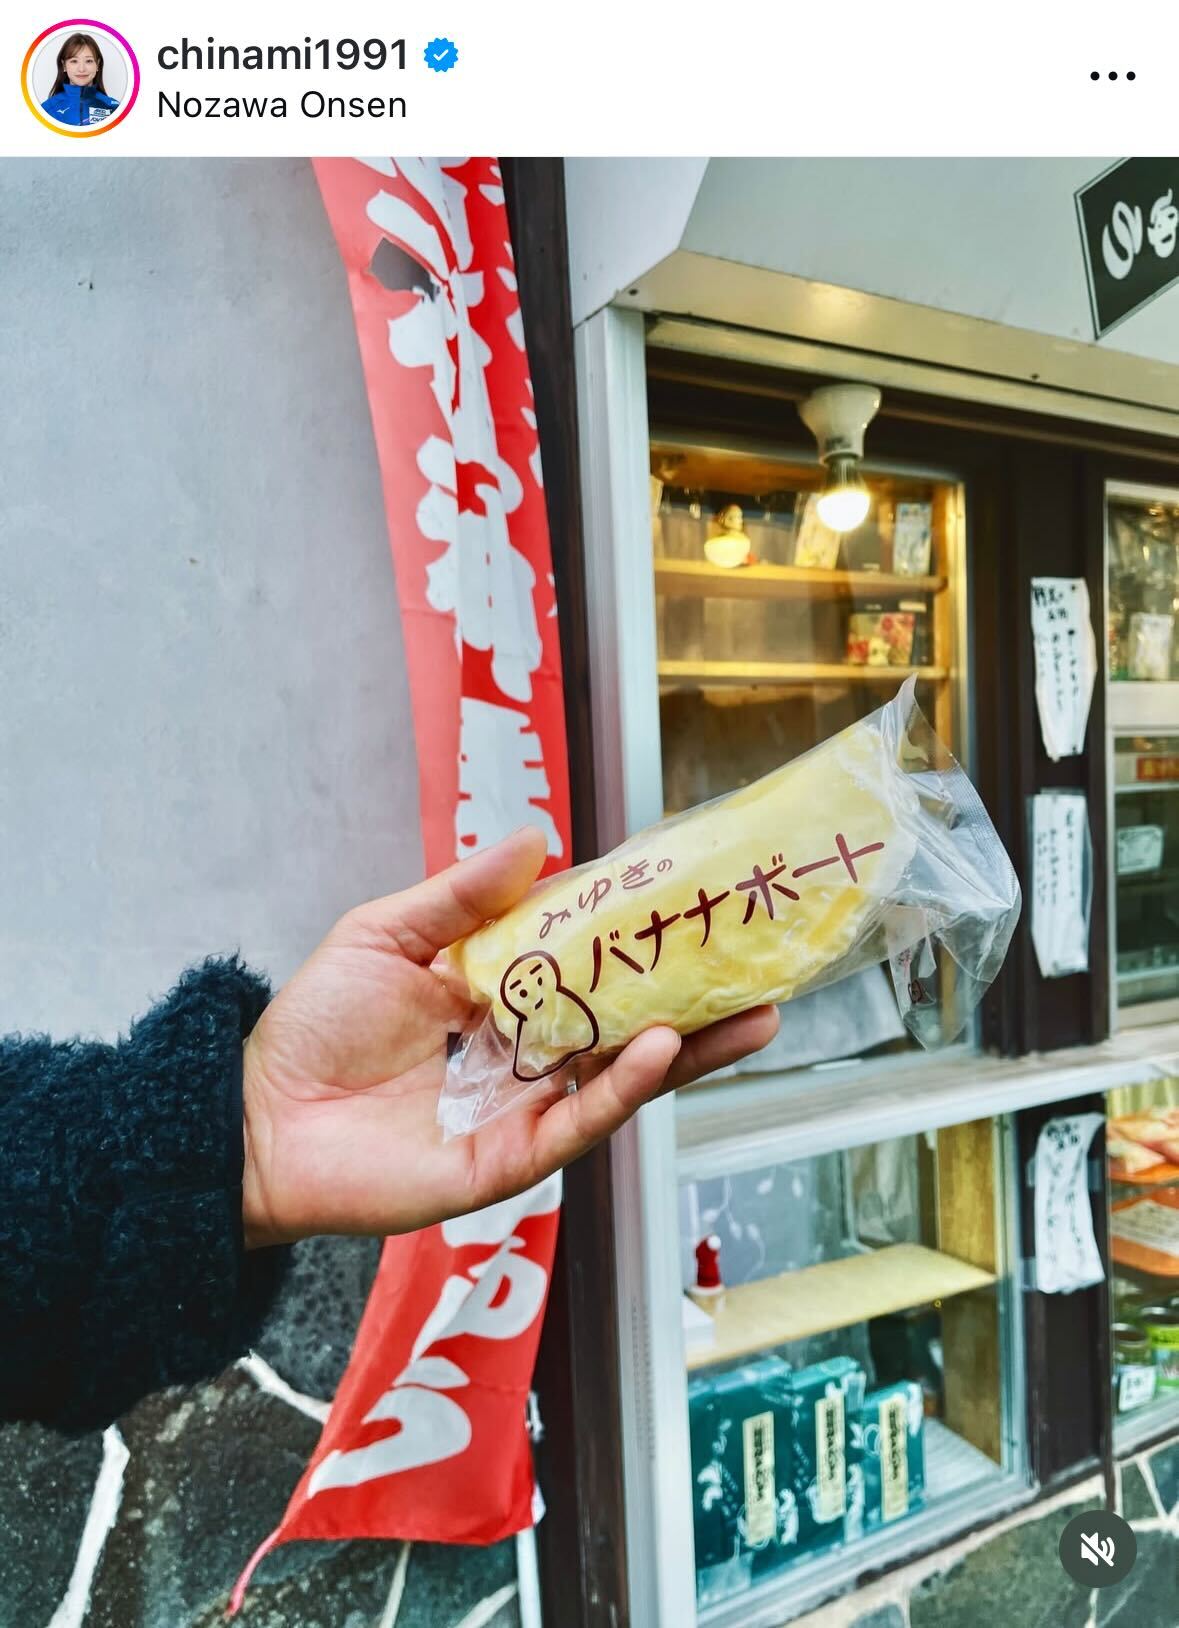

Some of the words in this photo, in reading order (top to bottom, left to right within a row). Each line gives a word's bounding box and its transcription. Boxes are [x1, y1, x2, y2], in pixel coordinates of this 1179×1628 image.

[539, 858, 673, 939] みゆきの
[589, 834, 885, 994] バナナボート
